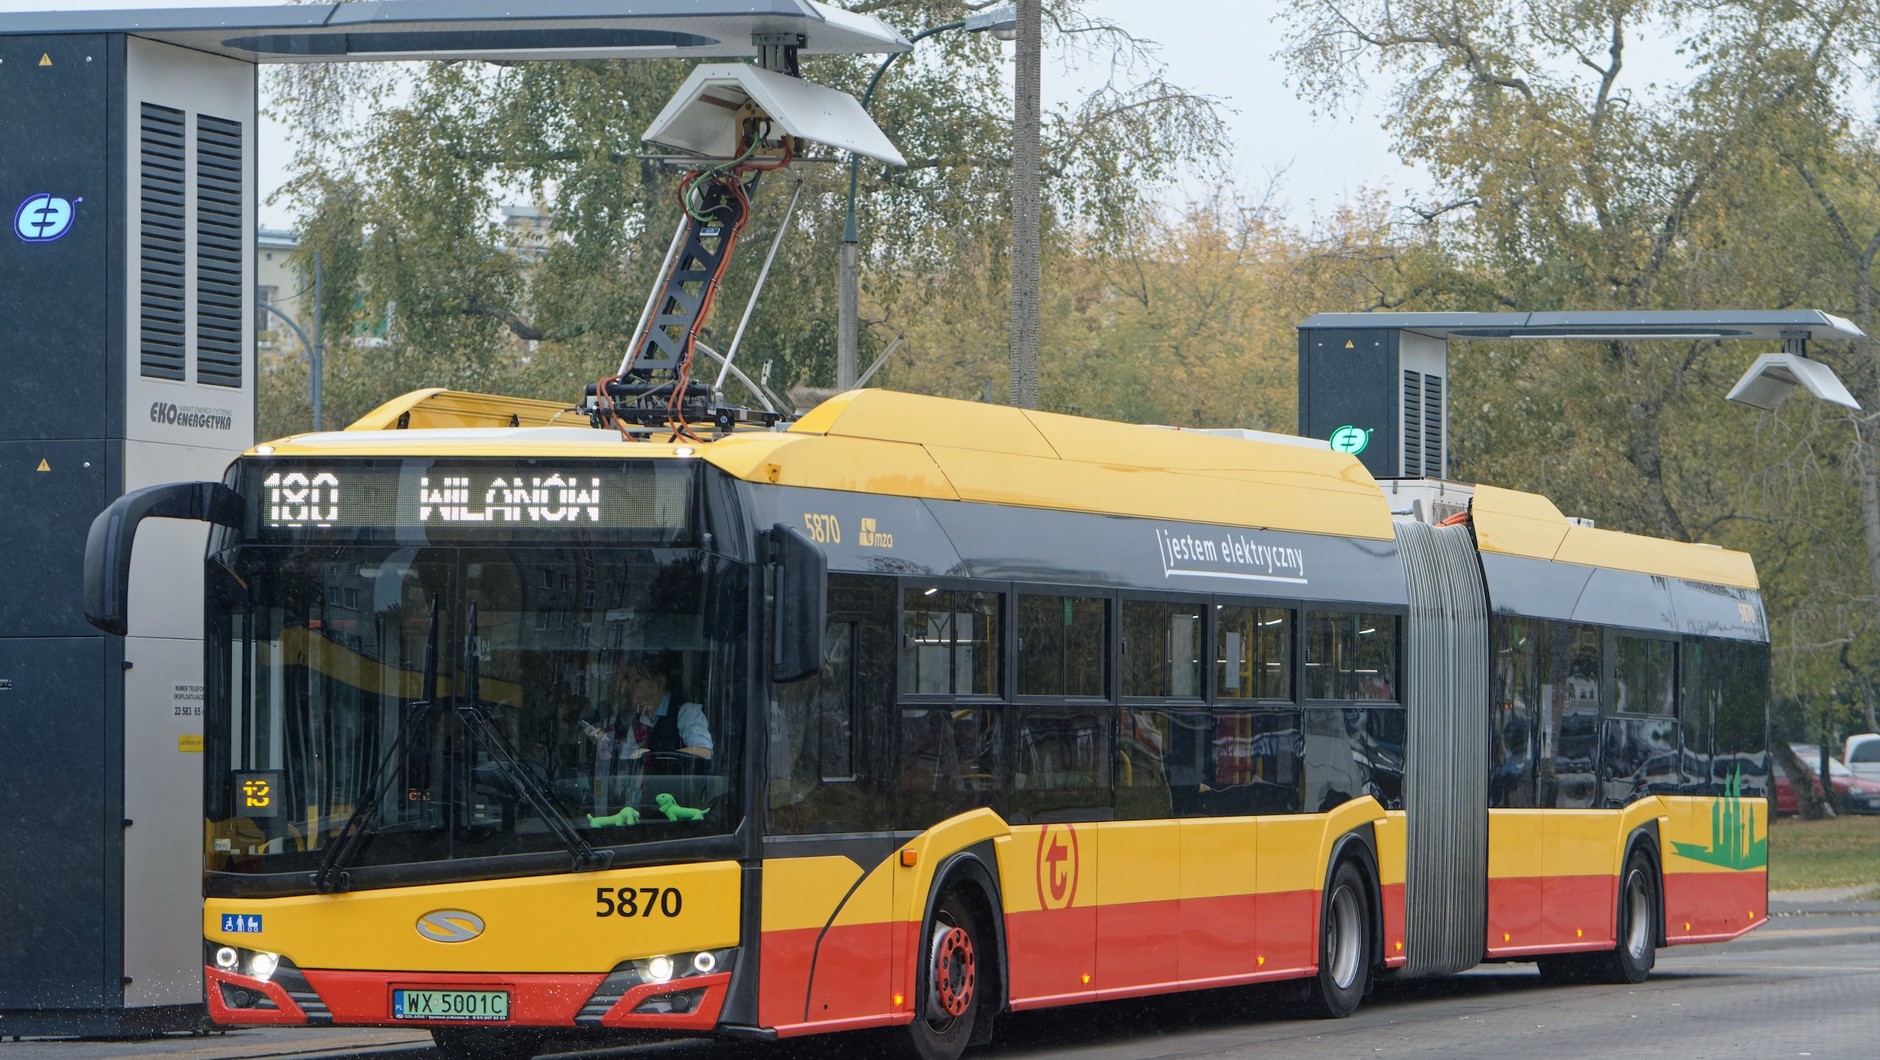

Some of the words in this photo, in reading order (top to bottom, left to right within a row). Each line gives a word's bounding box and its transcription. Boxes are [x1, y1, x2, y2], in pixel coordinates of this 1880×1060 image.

[150, 402, 177, 425] EKO
[263, 473, 339, 527] 180
[420, 474, 600, 521] WILANÓW
[804, 513, 841, 544] 5870
[874, 532, 893, 548] mza
[1164, 529, 1218, 567] jestem
[1221, 534, 1304, 577] elektryczny
[174, 706, 181, 716] 22
[182, 706, 192, 716] 583
[194, 707, 201, 716] 65
[243, 780, 270, 807] 13
[596, 887, 682, 918] 5870
[408, 993, 433, 1013] WX
[441, 993, 503, 1014] 5001C
